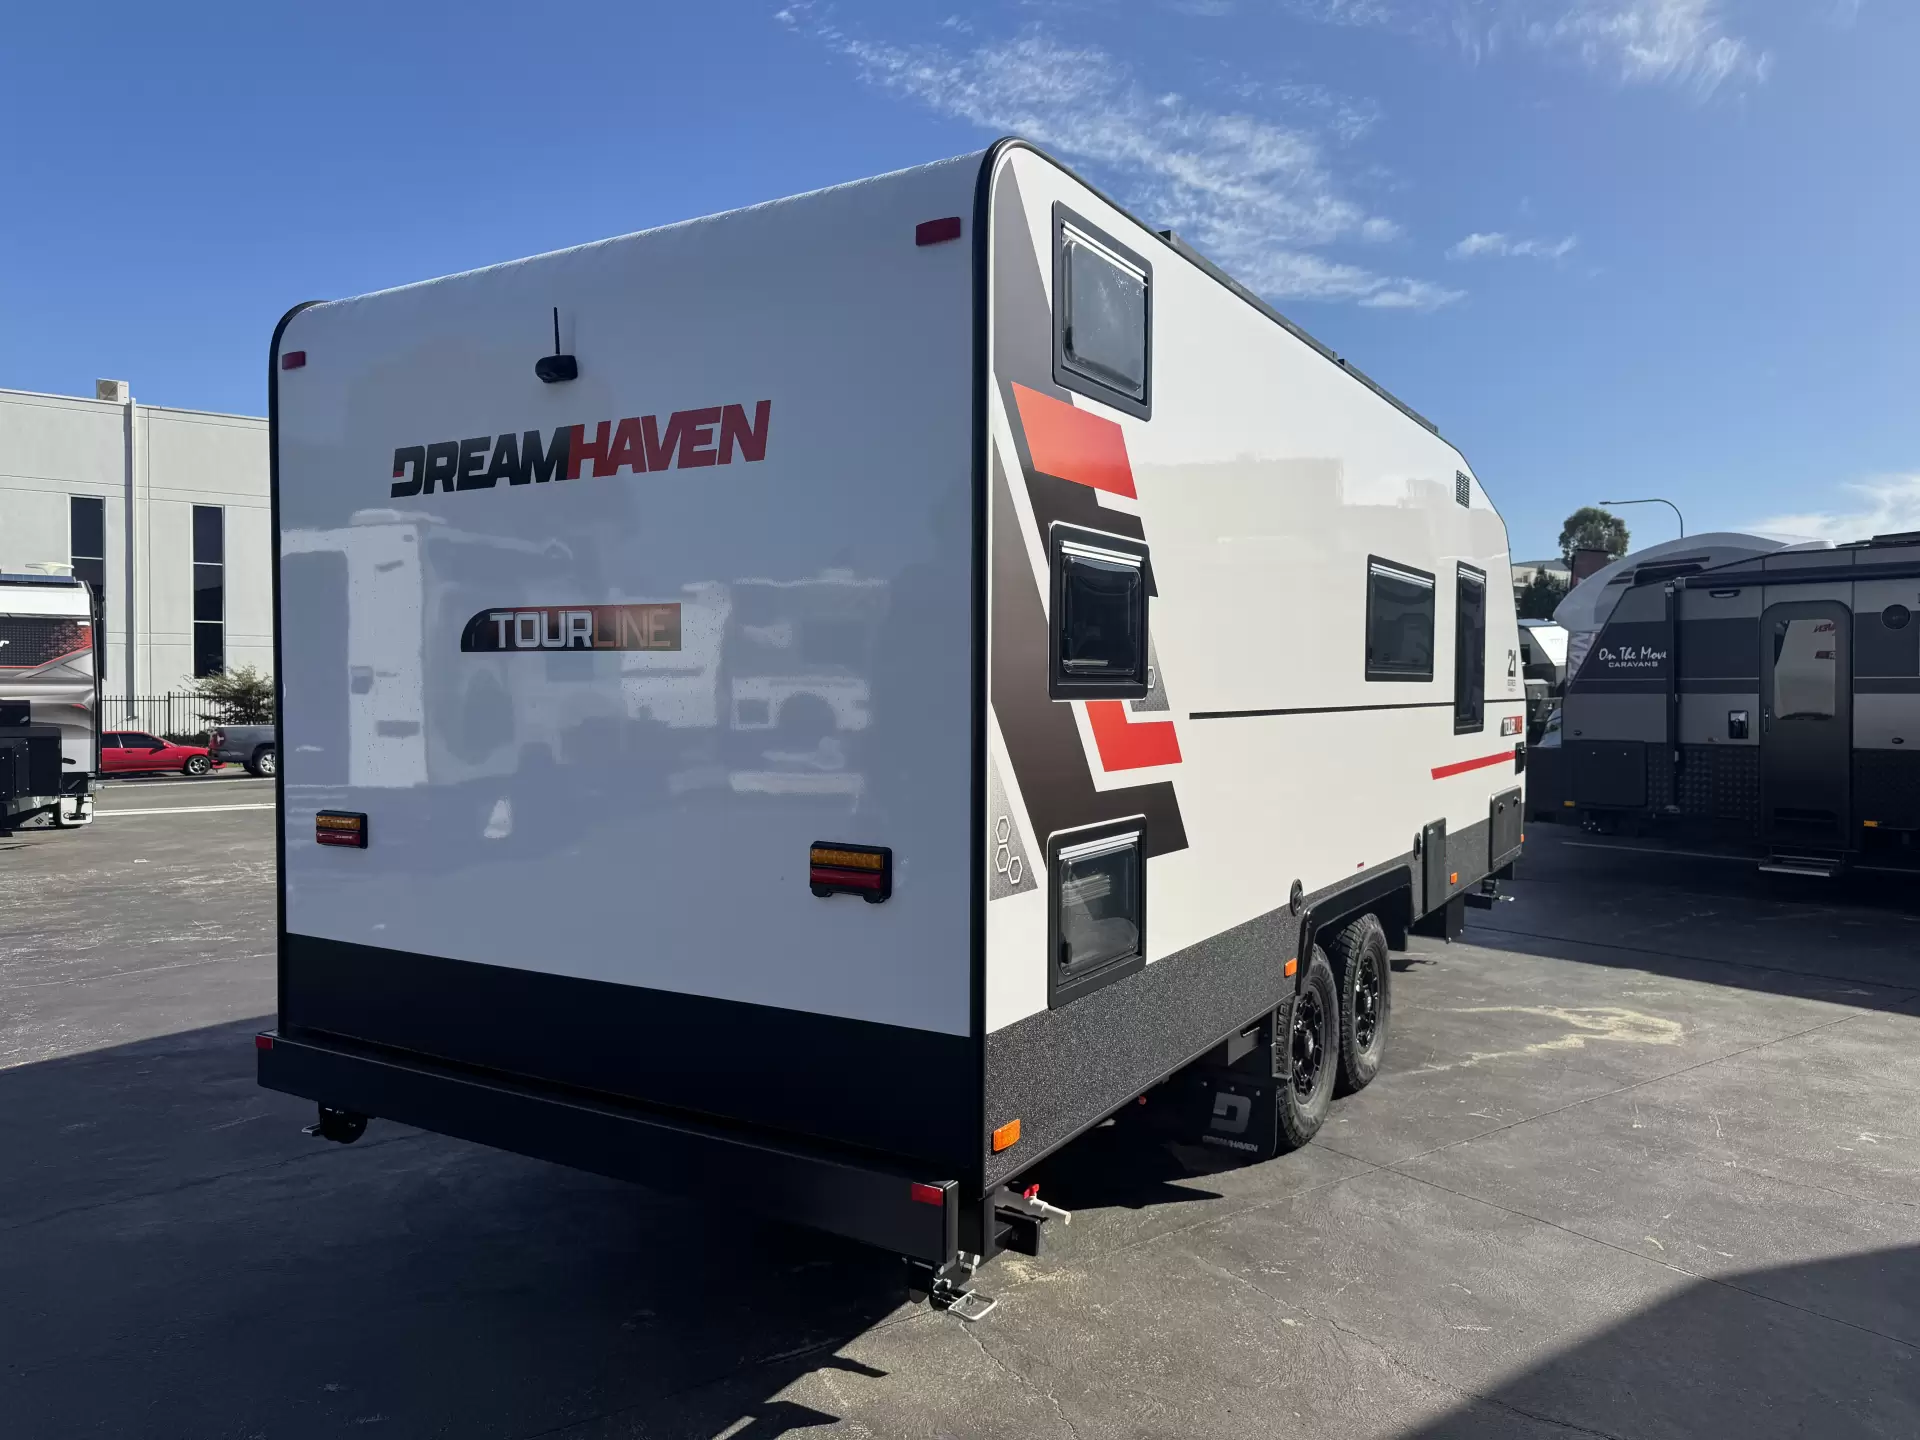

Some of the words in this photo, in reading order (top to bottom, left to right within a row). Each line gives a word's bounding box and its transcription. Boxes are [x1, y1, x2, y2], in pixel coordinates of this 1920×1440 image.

[390, 400, 772, 498] DREAMHAVEN
[489, 608, 671, 649] TOURLINE
[1507, 648, 1516, 677] 21
[1599, 647, 1616, 660] On
[1619, 646, 1636, 660] The
